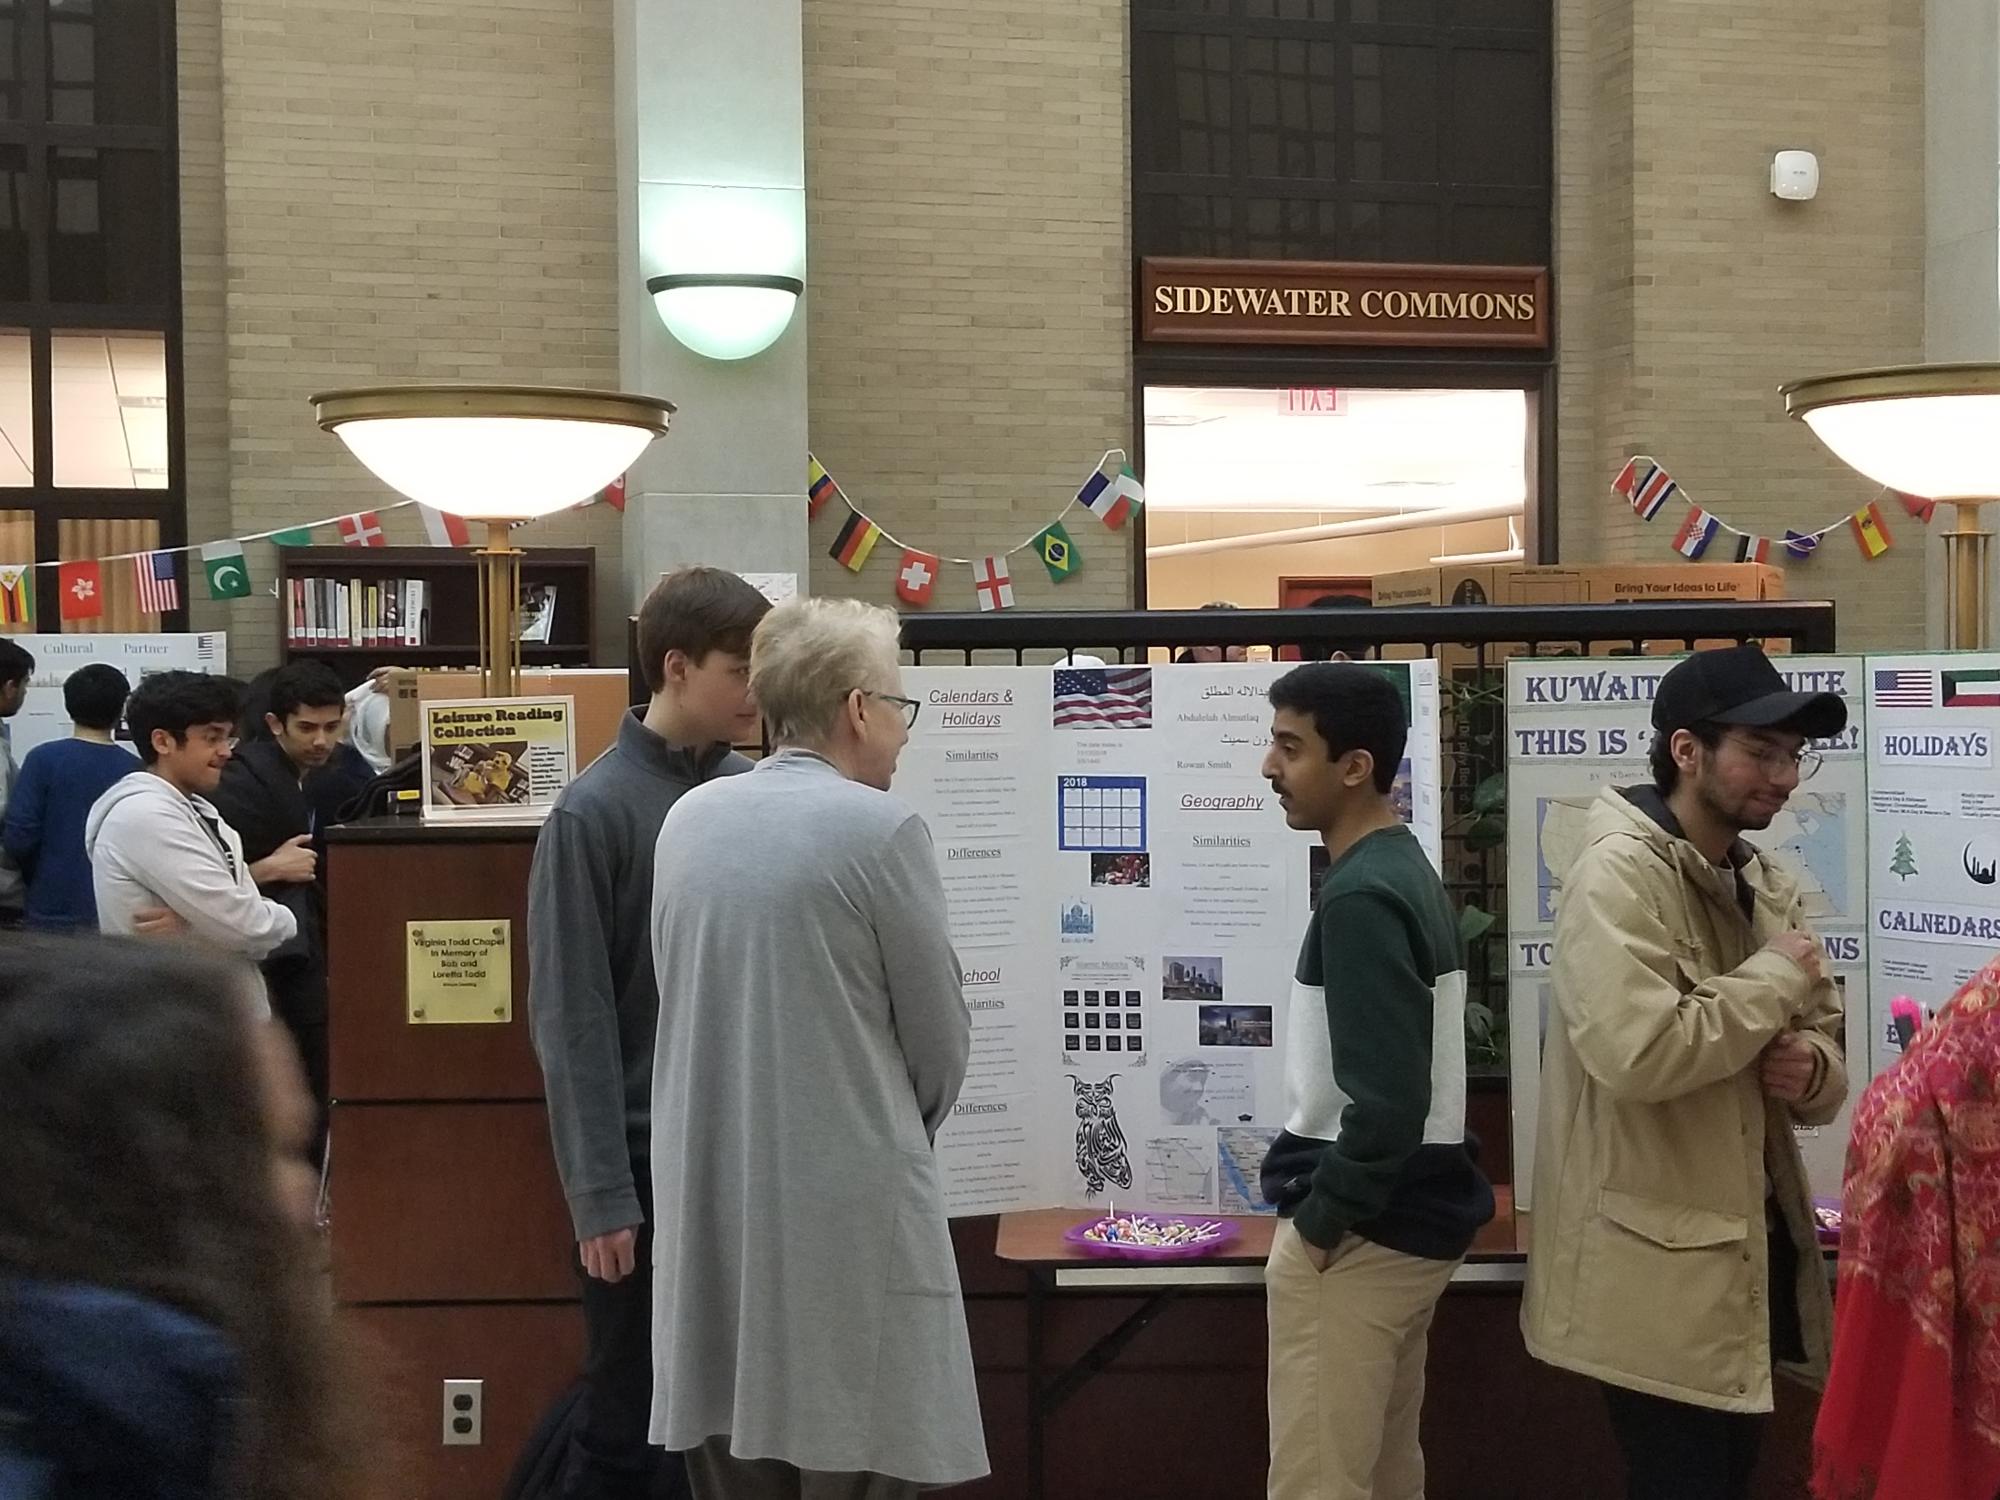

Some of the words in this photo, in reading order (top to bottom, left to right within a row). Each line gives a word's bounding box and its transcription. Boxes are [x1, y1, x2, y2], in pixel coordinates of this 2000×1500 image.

[1155, 285, 1352, 317] SIDEWATER
[1360, 289, 1535, 321] COMMONS
[1614, 583, 1643, 595] Bring
[1645, 583, 1672, 593] Your
[1673, 583, 1703, 593] Ideas
[1704, 583, 1715, 593] to
[1716, 582, 1739, 592] Life
[43, 643, 94, 654] Cultural
[124, 643, 169, 654] Partner
[929, 689, 1000, 704] Calendars
[1003, 689, 1013, 703] &
[432, 711, 493, 724] Leisure
[495, 708, 563, 722] Reading
[942, 712, 1001, 728] Holidays
[433, 725, 516, 739] Collection
[1515, 730, 1587, 755] THIS
[1599, 730, 1628, 755] IS
[1884, 732, 1988, 757] HOLIDAYS
[945, 749, 999, 761] Similarities
[1176, 761, 1205, 769] Rowan
[1207, 760, 1232, 769] Smith
[1063, 777, 1088, 787] 2018
[1181, 793, 1264, 811] Geography
[1192, 835, 1251, 847] Similarities
[947, 848, 1001, 859] Differences
[414, 938, 447, 948] Virginia
[449, 938, 470, 946] Todd
[472, 938, 505, 947] Chapel
[441, 949, 476, 957] Memory
[432, 970, 462, 978] Loretta
[464, 970, 486, 978] Todd
[963, 968, 1001, 982] chool
[953, 1103, 1008, 1115] Differences
